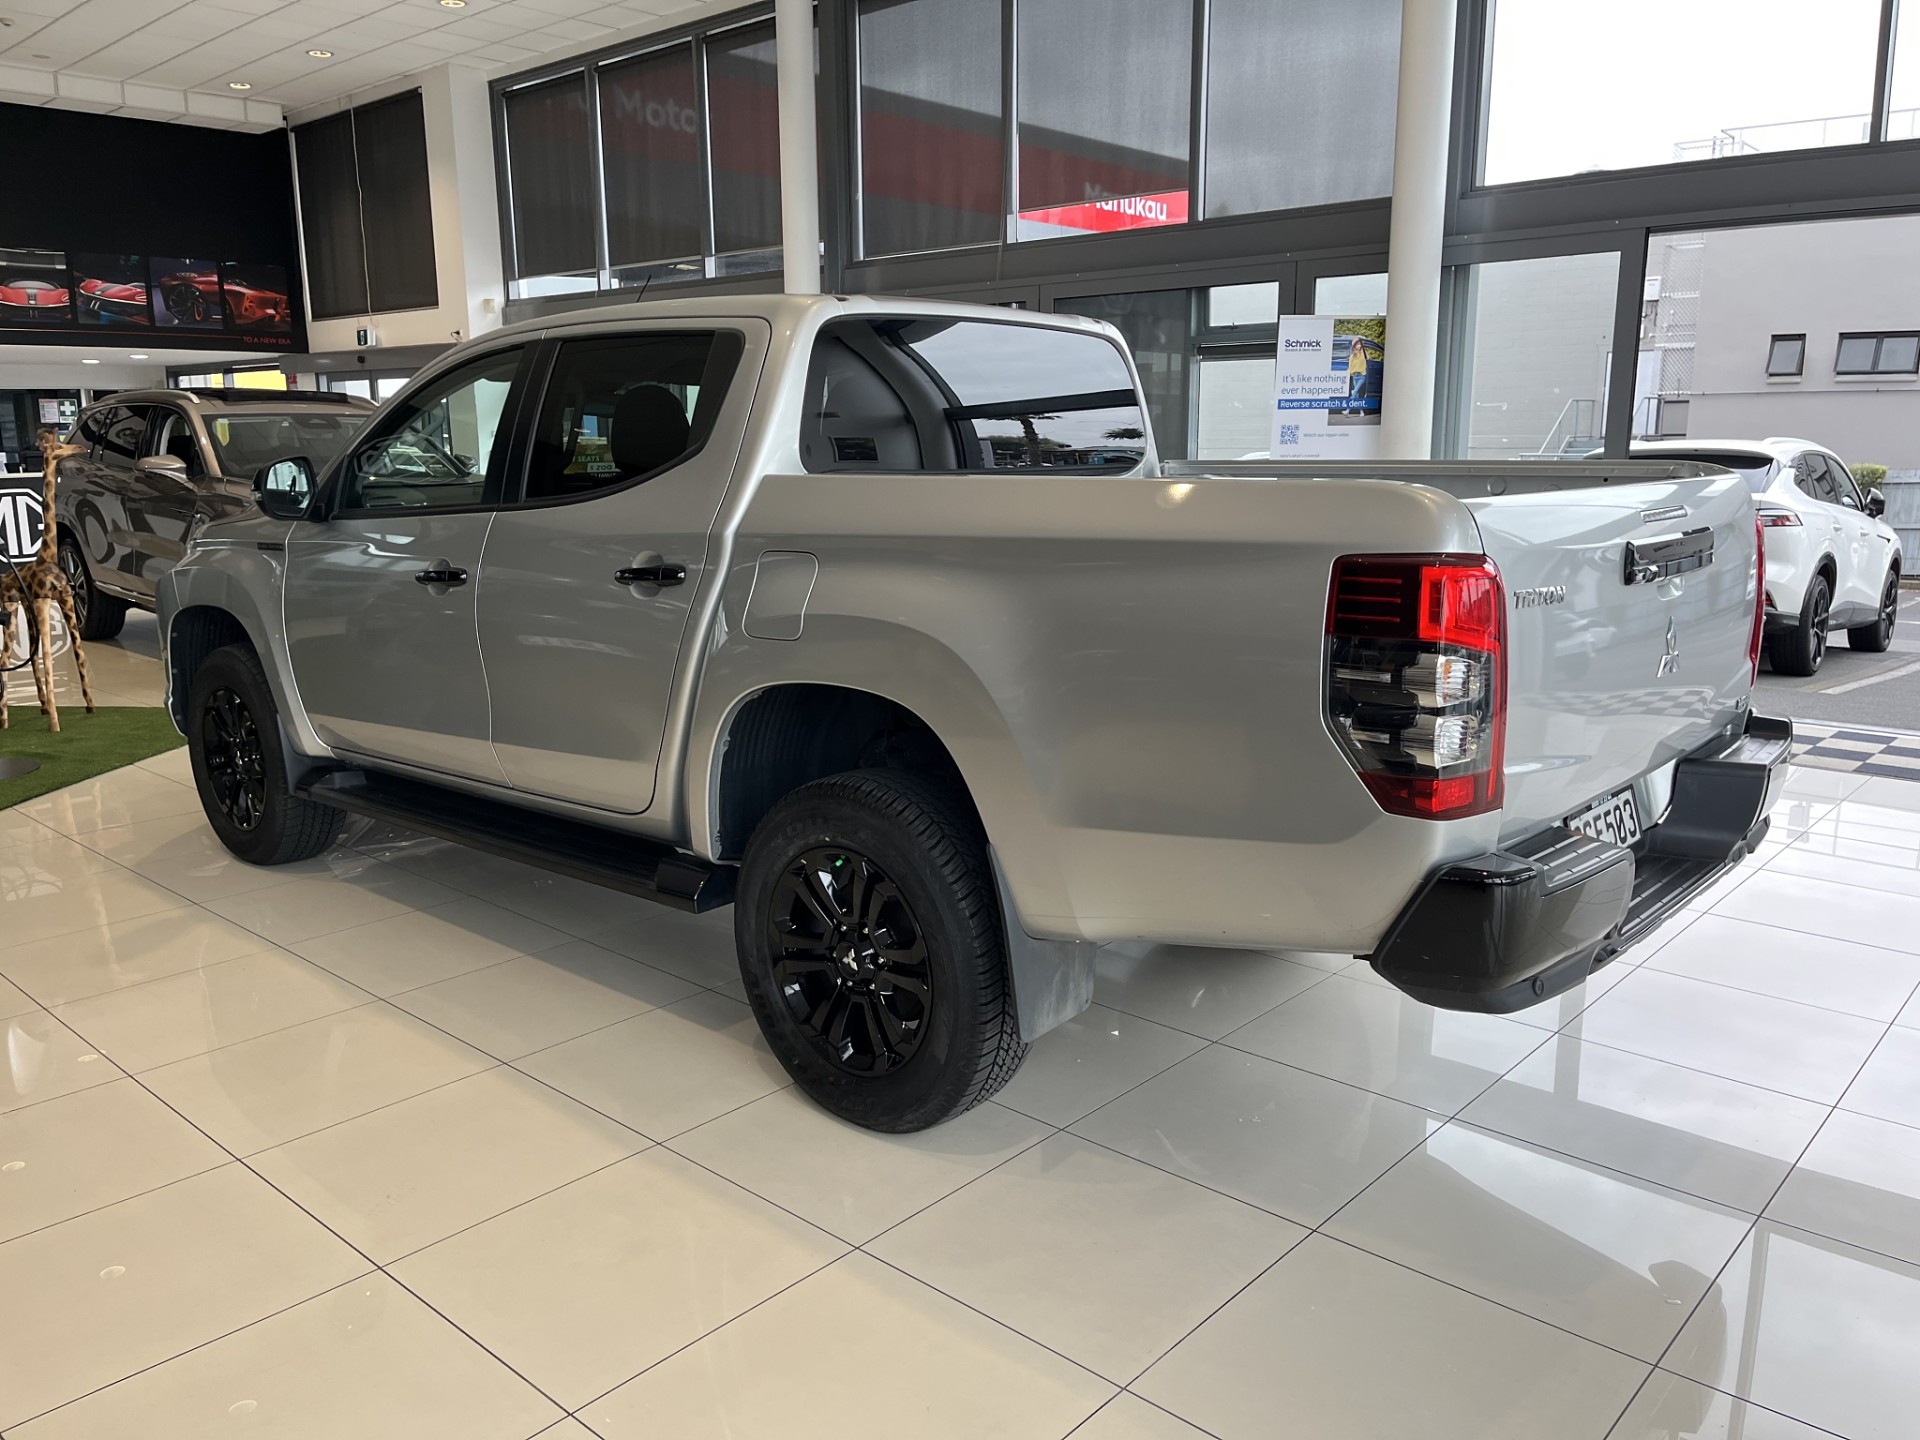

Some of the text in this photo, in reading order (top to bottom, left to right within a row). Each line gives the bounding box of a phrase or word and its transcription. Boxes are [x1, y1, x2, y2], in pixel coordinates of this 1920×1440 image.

[1284, 339, 1322, 348] Schmick
[1282, 374, 1347, 385] It's like nothing
[1281, 385, 1346, 396] ever happened.
[1280, 399, 1368, 408] Reverse scratch & dent.
[1513, 585, 1566, 609] TRITON
